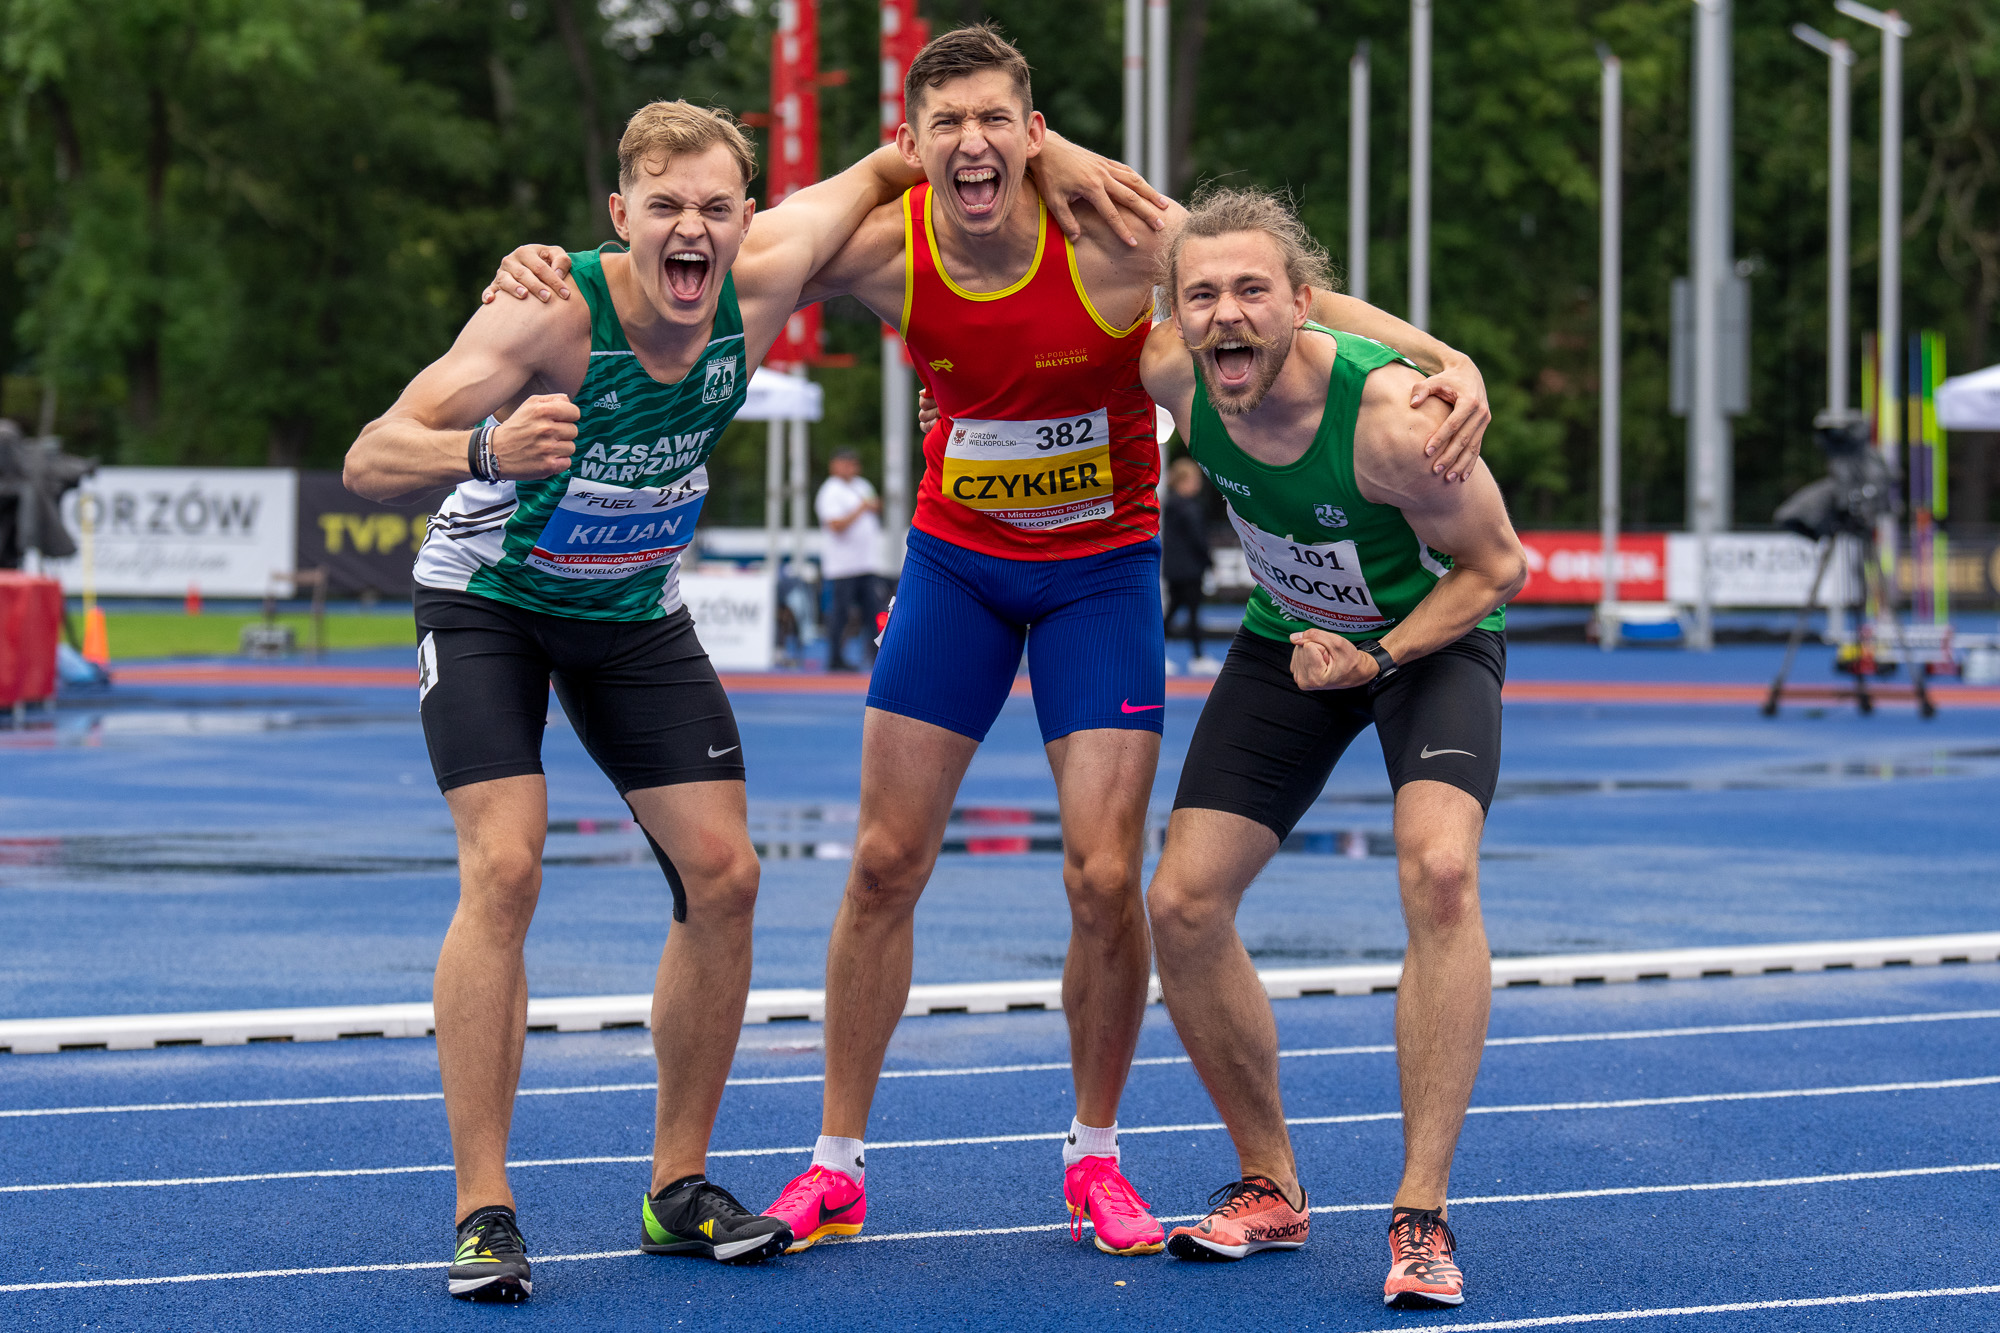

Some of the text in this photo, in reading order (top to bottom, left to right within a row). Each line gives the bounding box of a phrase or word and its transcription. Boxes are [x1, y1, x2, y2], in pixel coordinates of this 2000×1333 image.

[1035, 354, 1089, 369] BIAŁYSTOK
[1047, 347, 1087, 359] PODLASIE
[593, 400, 621, 411] adidas
[968, 439, 1017, 447] WIELKOPOLSKI
[970, 431, 998, 440] GORZÓW
[1035, 418, 1094, 450] 382
[953, 462, 1101, 500] CZYKIER
[1215, 474, 1251, 497] UMCS
[74, 480, 260, 537] ORZÓW
[586, 496, 638, 509] FUEL
[1007, 506, 1065, 519] Mistrzostwa
[1066, 500, 1093, 513] Polski
[1081, 506, 1107, 517] 2023
[566, 514, 684, 545] KILJAN
[534, 558, 654, 575] GORZÓW WIELKOPOLSKI
[591, 553, 645, 564] Mistrzostwa
[1288, 545, 1346, 572] 101
[1243, 539, 1369, 607] SIEROCKI
[419, 644, 431, 691] 4
